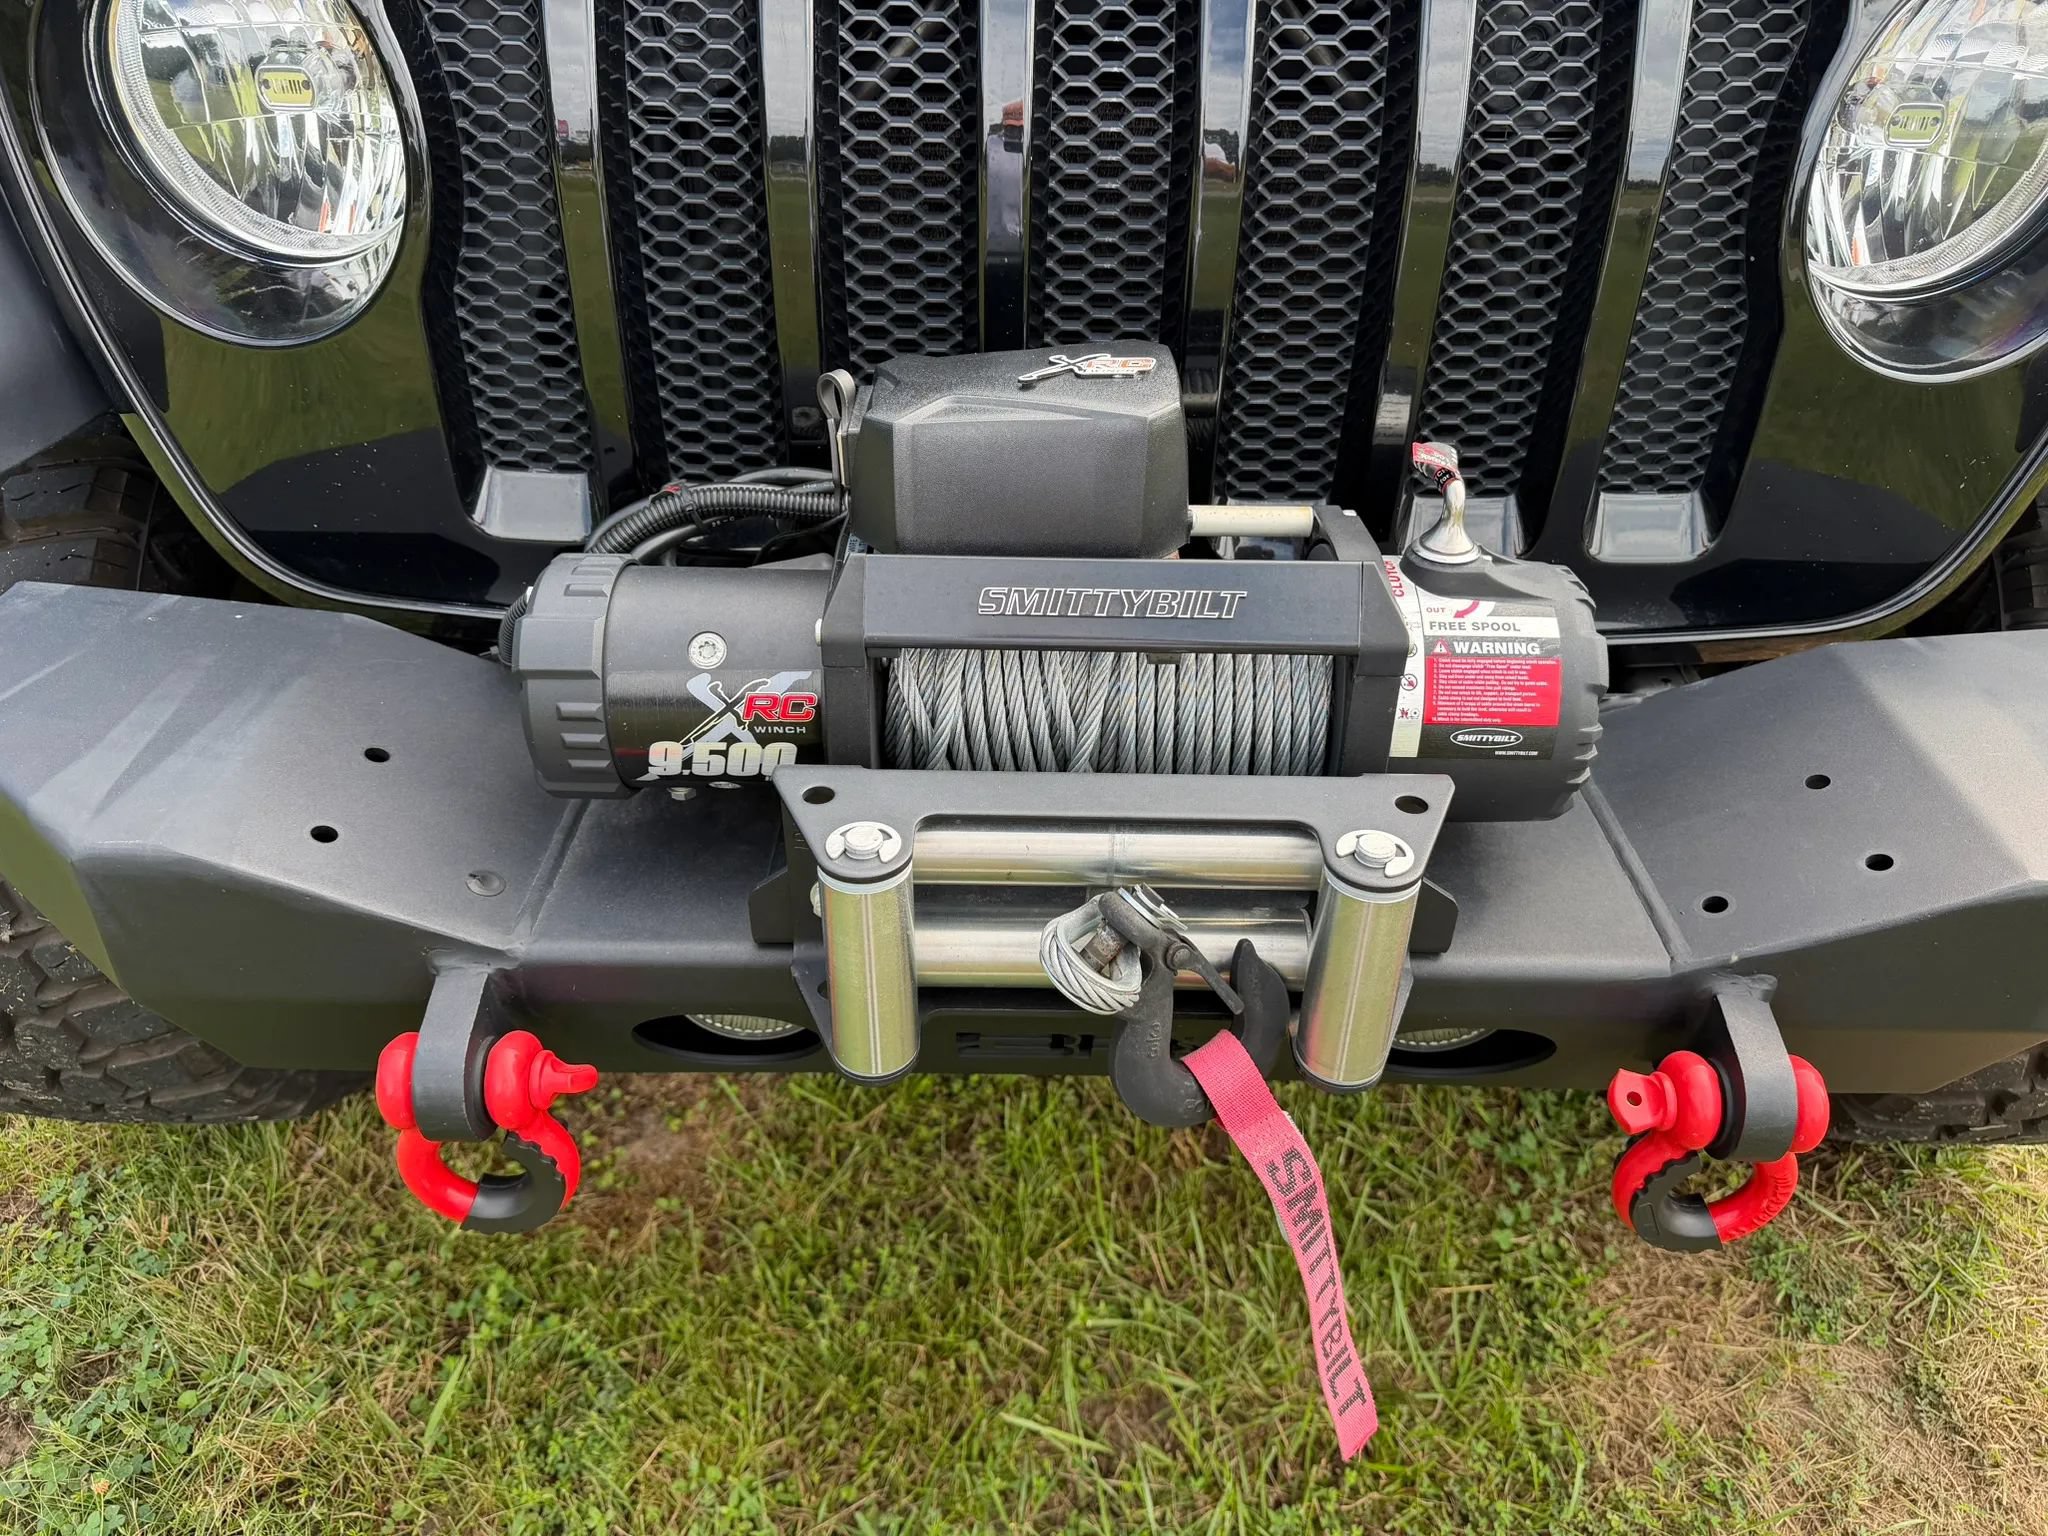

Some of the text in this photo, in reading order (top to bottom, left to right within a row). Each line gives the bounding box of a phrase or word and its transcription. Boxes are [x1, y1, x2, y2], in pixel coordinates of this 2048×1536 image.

[978, 586, 1247, 619] SMITTYBILT
[1429, 621, 1521, 632] FREE SPOOL
[1452, 641, 1541, 655] WARNING
[753, 726, 807, 734] WINCH
[1456, 734, 1517, 743] SMITTYBILT
[1265, 1146, 1367, 1416] SMITTYBILT
